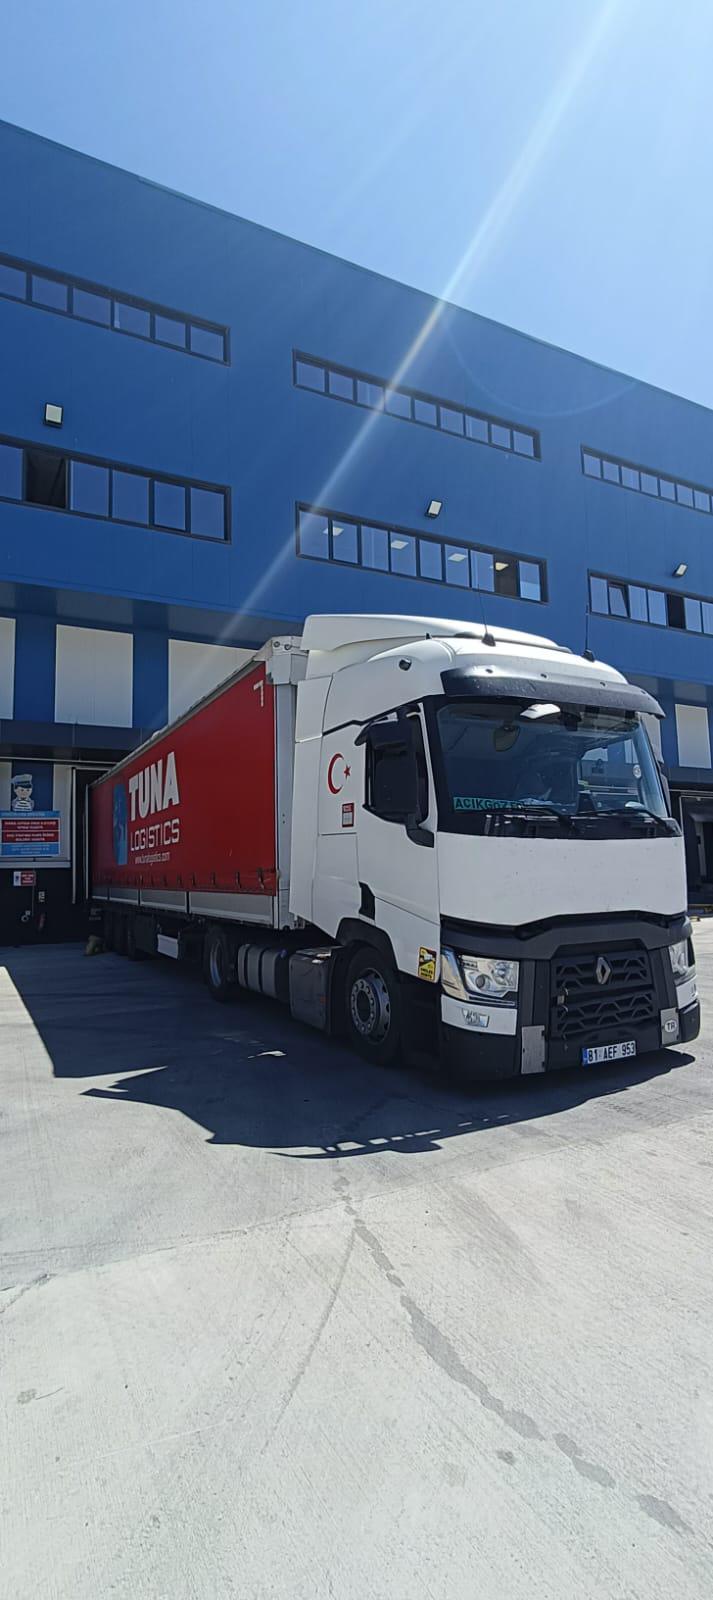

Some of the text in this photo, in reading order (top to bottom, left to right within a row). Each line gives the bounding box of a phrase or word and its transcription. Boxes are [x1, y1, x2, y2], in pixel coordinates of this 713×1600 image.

[128, 751, 180, 821] TUNA
[131, 819, 180, 851] LOGISTICS
[667, 1022, 676, 1030] TR
[588, 1042, 635, 1062] 81 AEF 953
